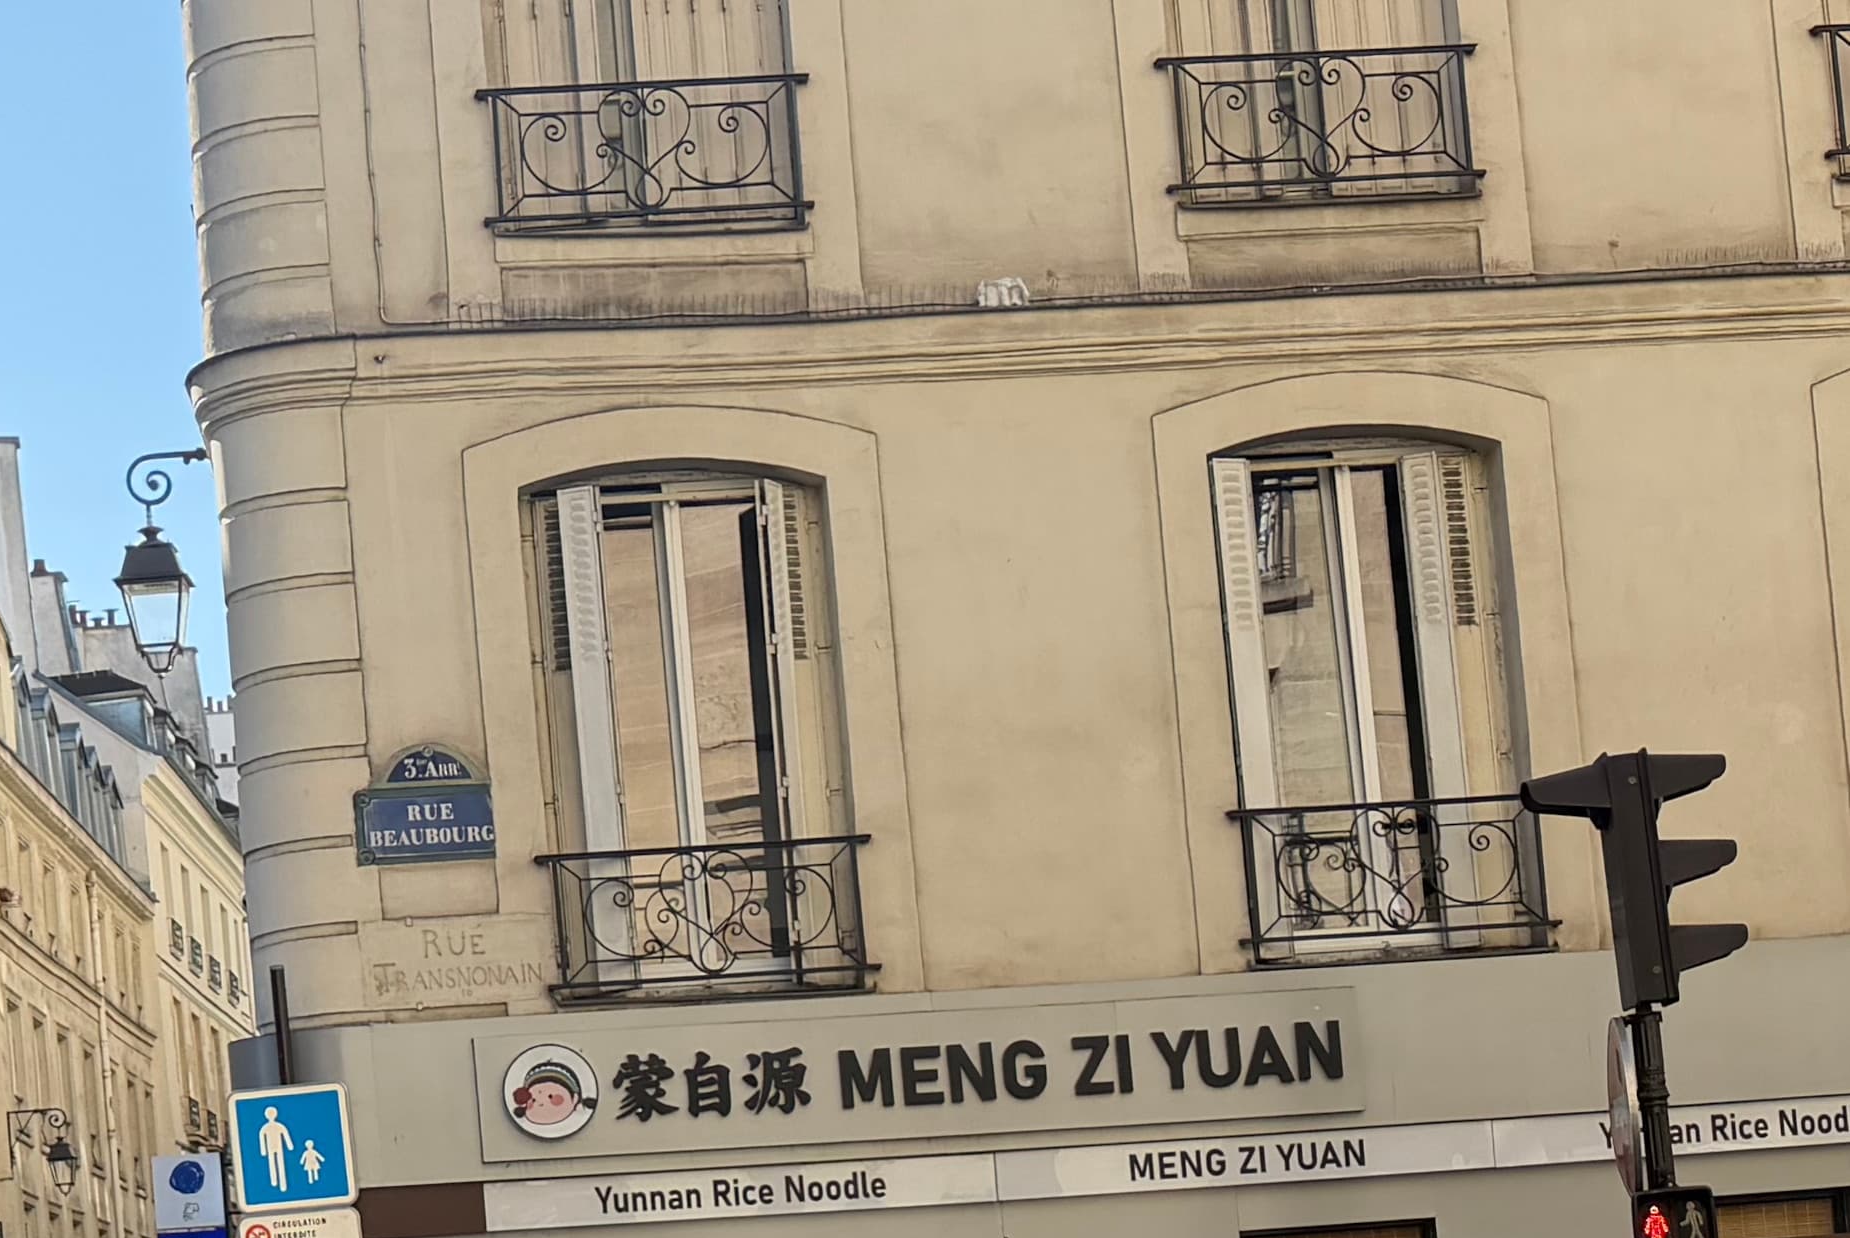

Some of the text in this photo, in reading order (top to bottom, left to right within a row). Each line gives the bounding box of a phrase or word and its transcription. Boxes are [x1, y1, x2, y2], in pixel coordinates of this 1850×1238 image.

[407, 803, 455, 821] RUE
[370, 825, 495, 848] BEAUBOURG
[422, 928, 486, 959] RUE
[373, 962, 543, 993] TRANSNONAIN
[838, 1020, 1344, 1110] MENG ZI YUAN
[613, 1046, 812, 1123] 蒙自源
[1598, 1105, 1850, 1149] Yan Rice Nood
[1128, 1139, 1366, 1182] MENG ZI YUAN
[594, 1170, 887, 1215] Yunnan Rice Noodle
[272, 1217, 327, 1229] CIRCULATION
